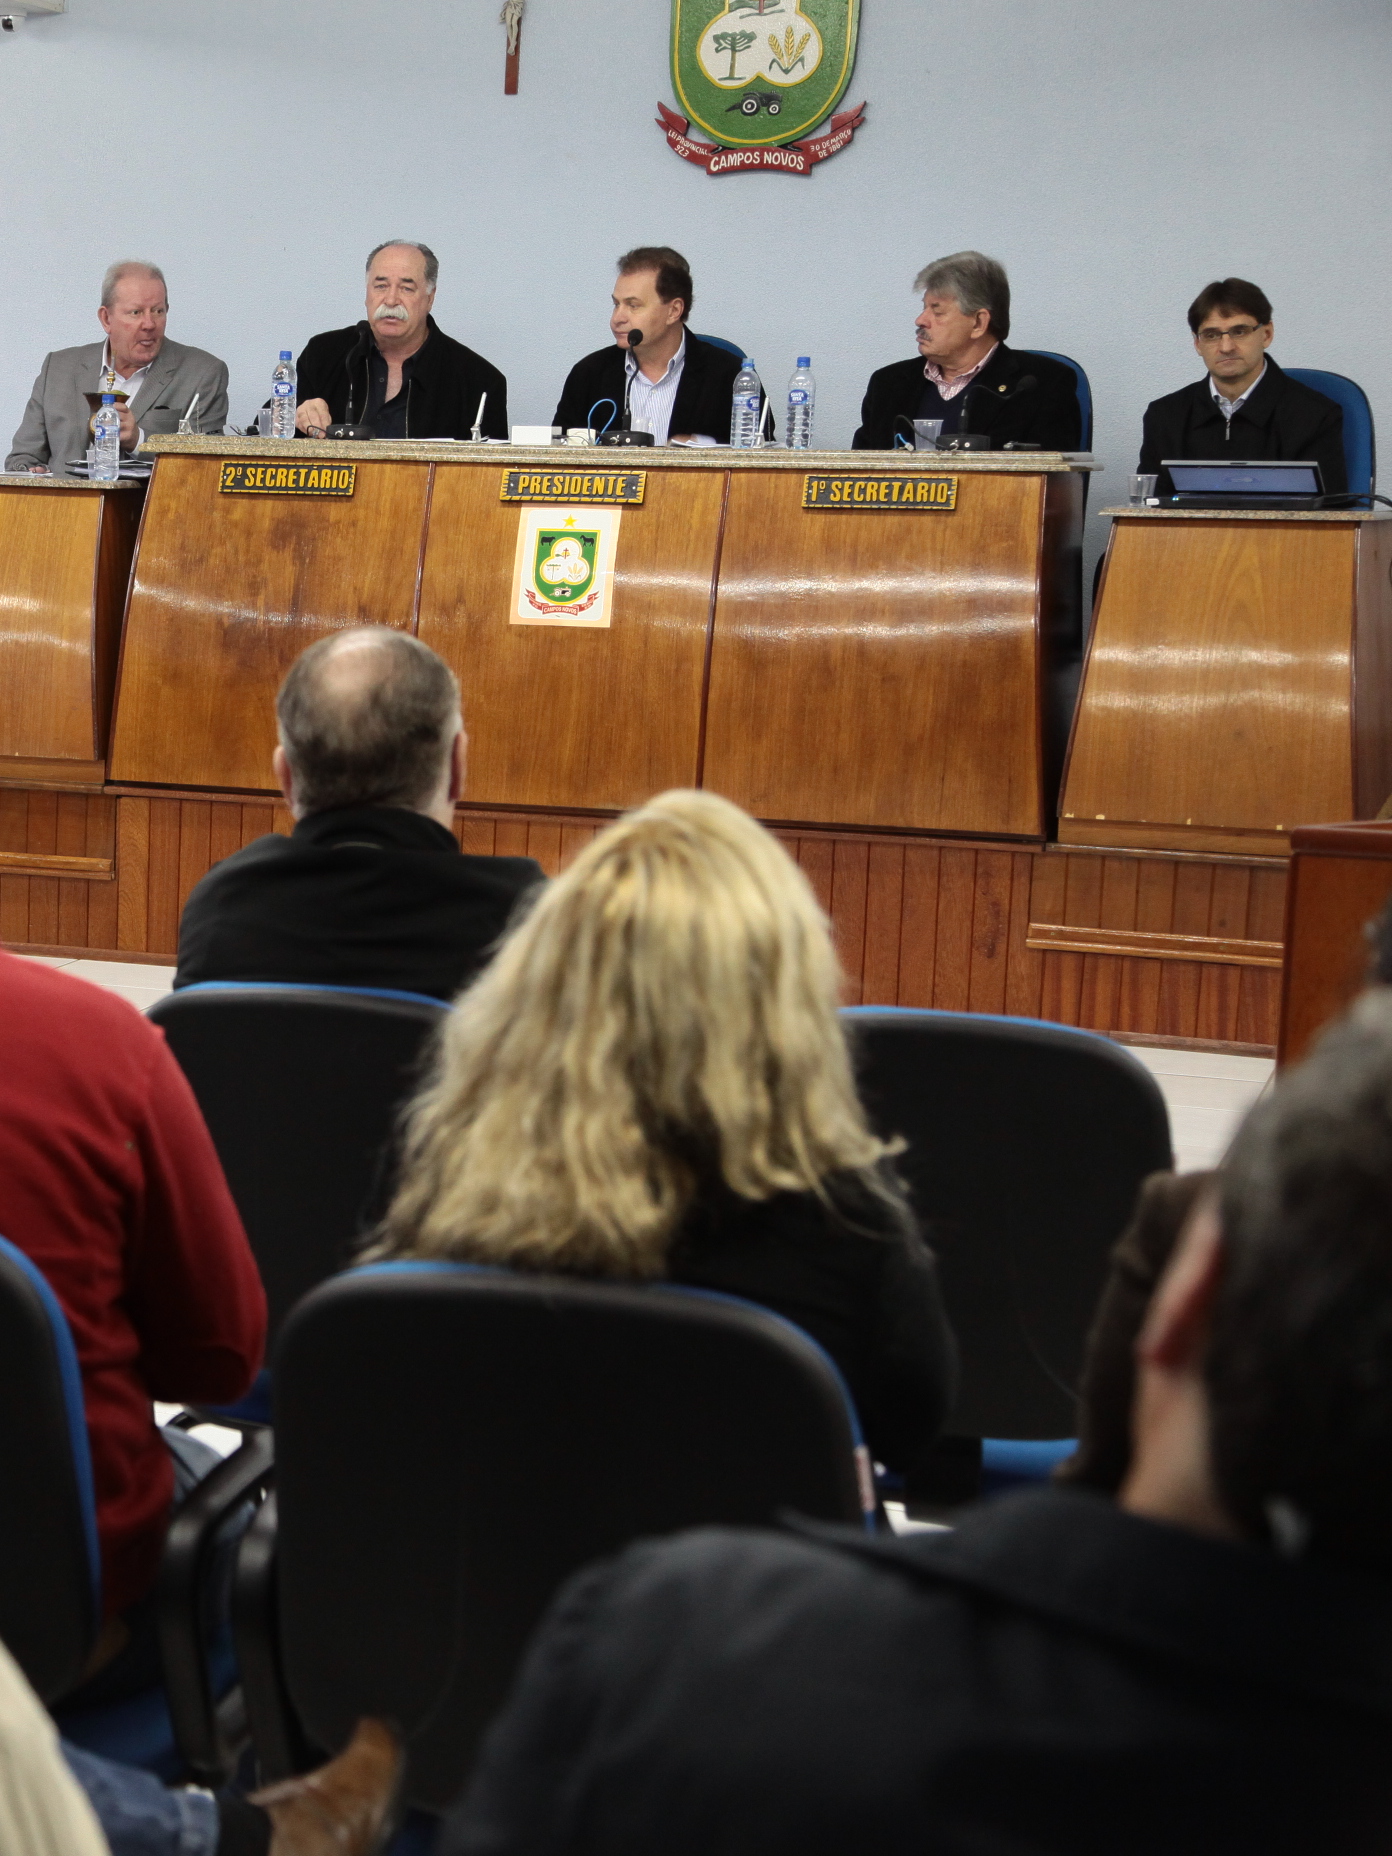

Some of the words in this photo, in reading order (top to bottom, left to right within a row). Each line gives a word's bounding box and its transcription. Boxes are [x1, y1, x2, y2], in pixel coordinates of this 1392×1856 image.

[674, 144, 690, 157] 923
[817, 149, 828, 158] DE
[710, 151, 760, 172] CAMPOS
[763, 151, 805, 171] NOVOS
[244, 466, 350, 489] SECRETÁRIO
[518, 475, 627, 496] PRESIDENTE
[830, 479, 949, 503] SECRETÁRIO
